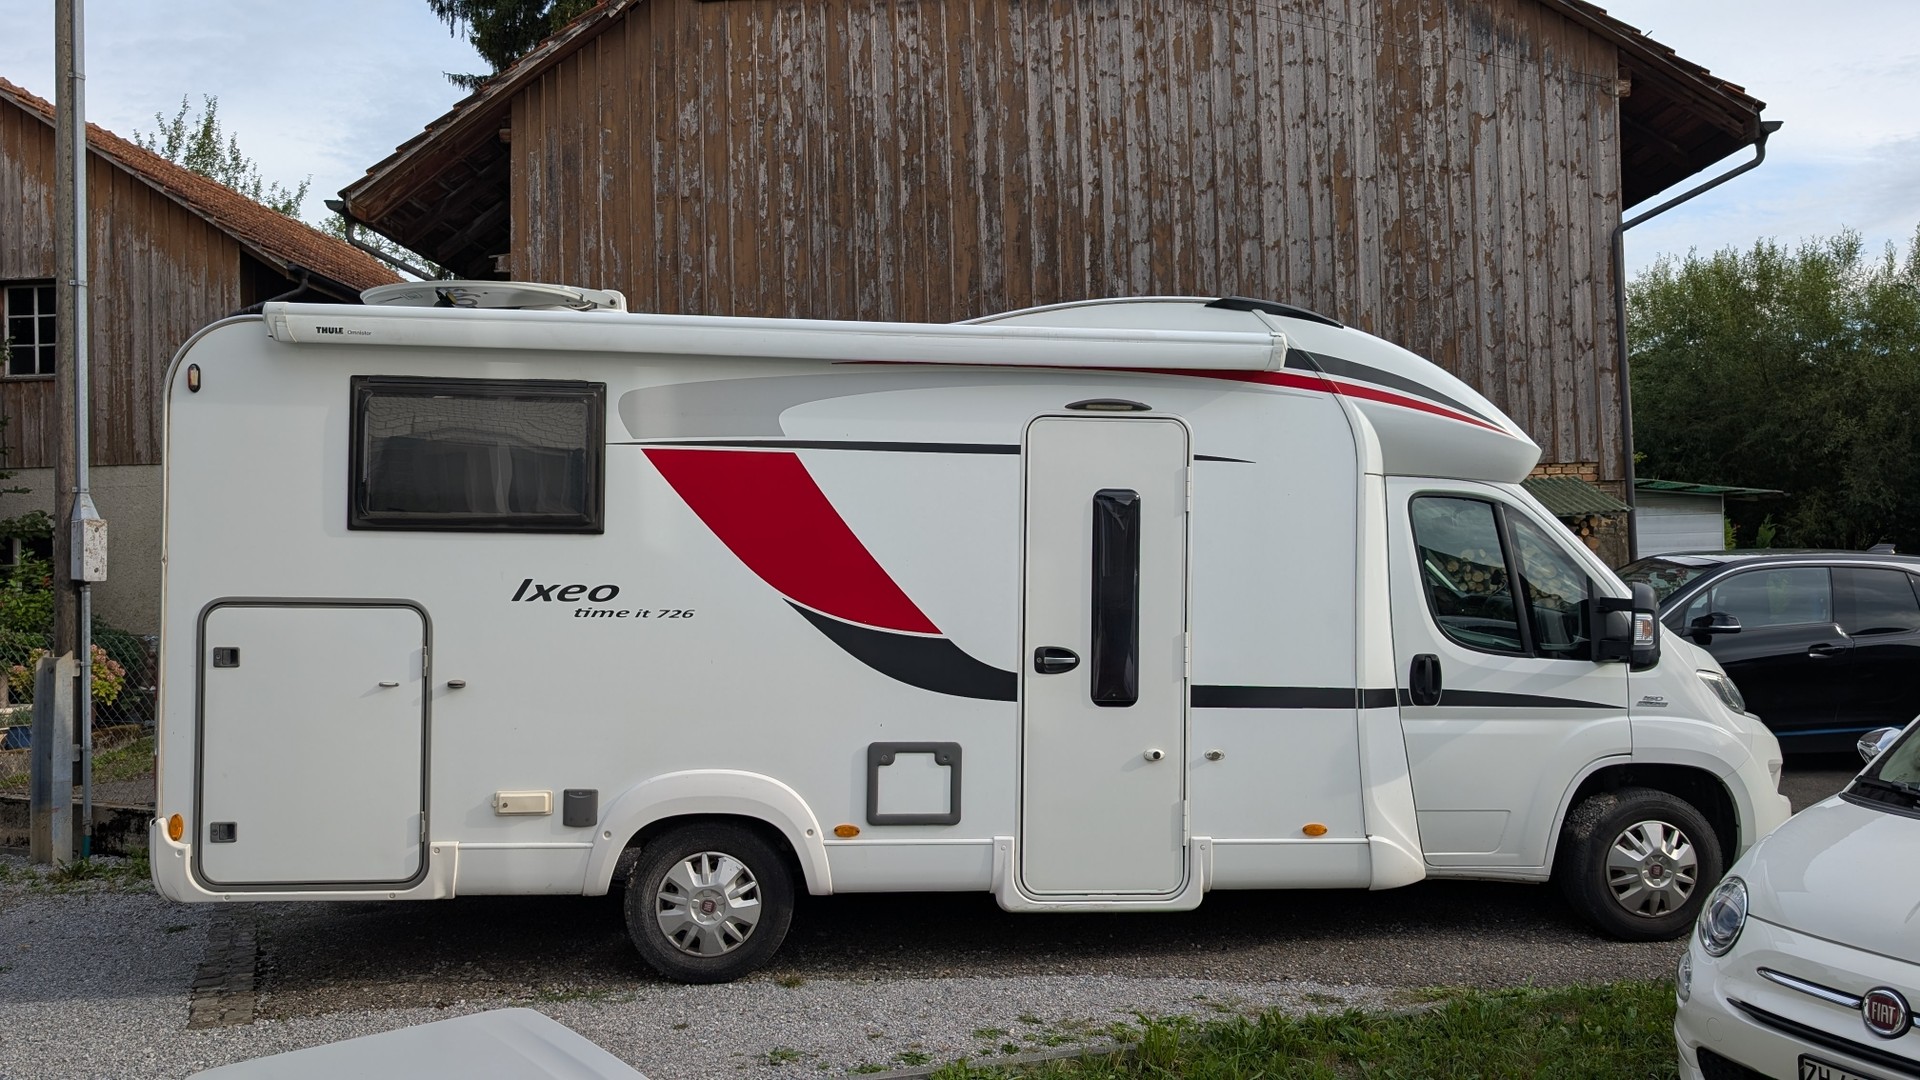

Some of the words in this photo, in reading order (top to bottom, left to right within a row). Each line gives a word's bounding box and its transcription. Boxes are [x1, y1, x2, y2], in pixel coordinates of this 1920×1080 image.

[315, 326, 344, 335] THULE
[511, 578, 620, 602] Ixeo
[573, 607, 630, 618] time
[634, 609, 651, 619] it
[656, 609, 695, 619] 726
[1871, 1001, 1896, 1025] FIAT
